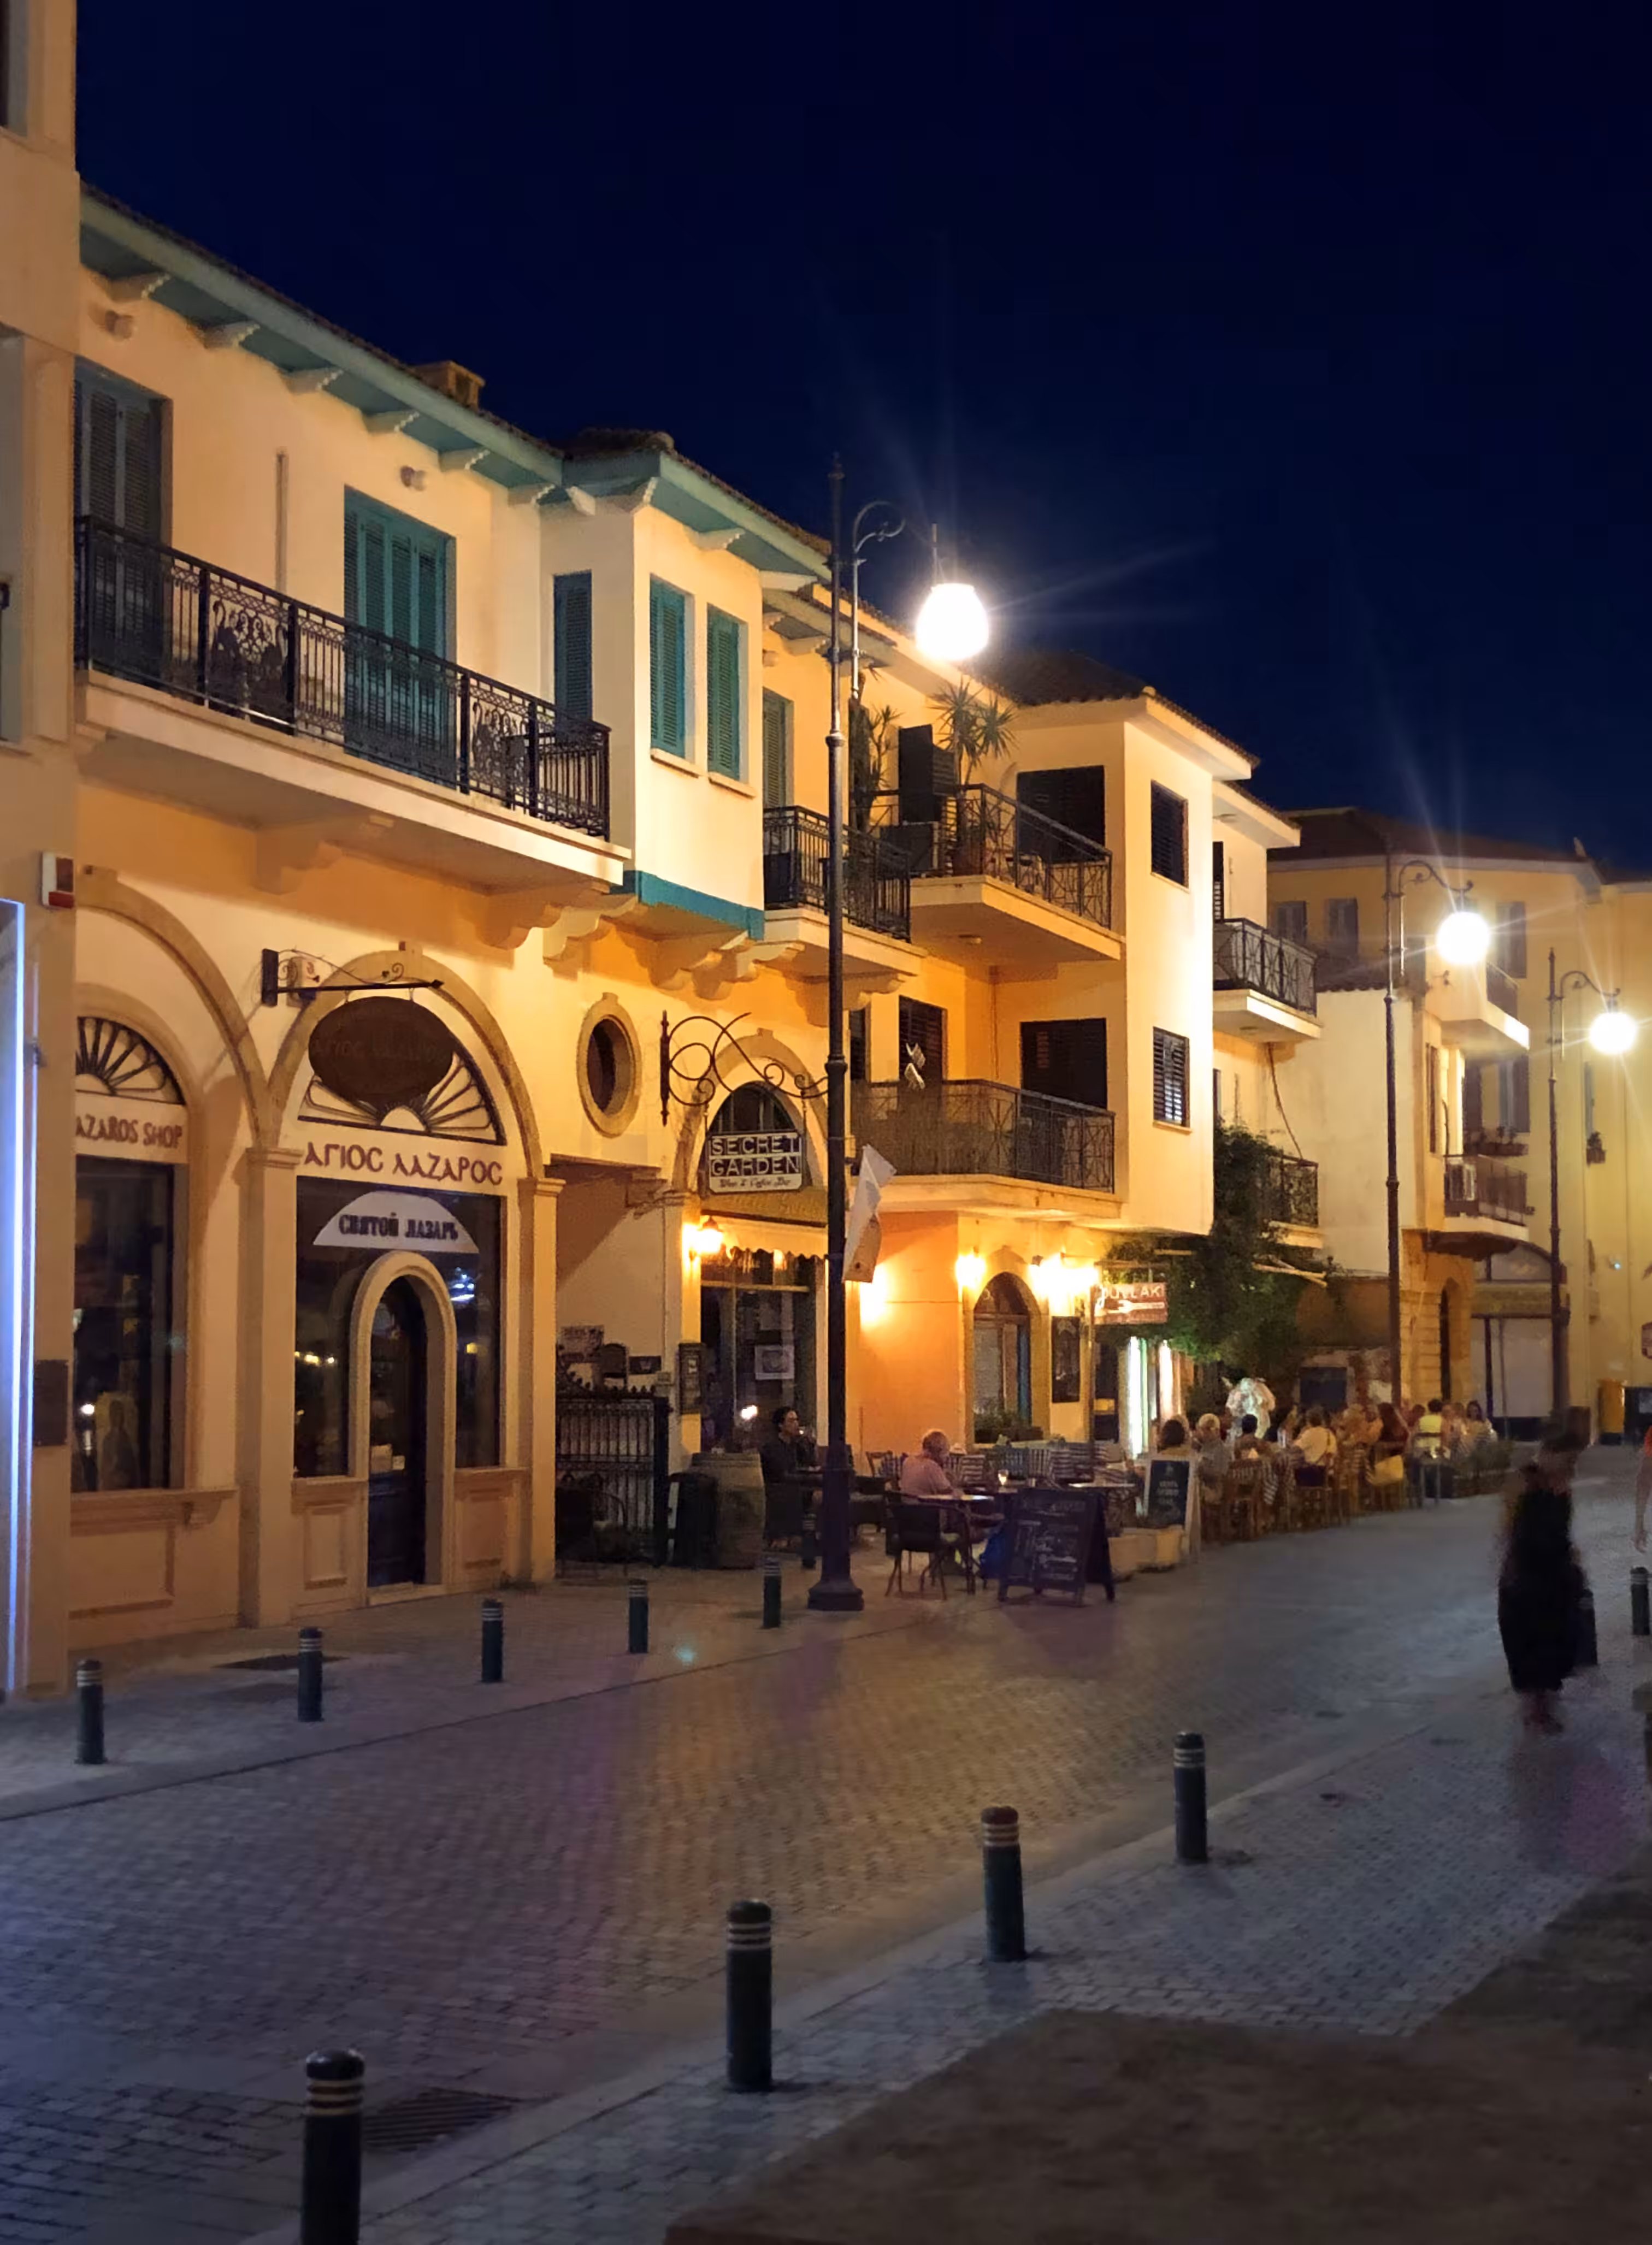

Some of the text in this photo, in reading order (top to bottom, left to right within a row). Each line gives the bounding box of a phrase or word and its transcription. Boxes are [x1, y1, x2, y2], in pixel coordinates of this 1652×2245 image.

[143, 1122, 182, 1148] SHOP
[712, 1135, 798, 1155] SECRET
[712, 1156, 799, 1175] GARDEN
[339, 1212, 399, 1237] СВЯТОЙ
